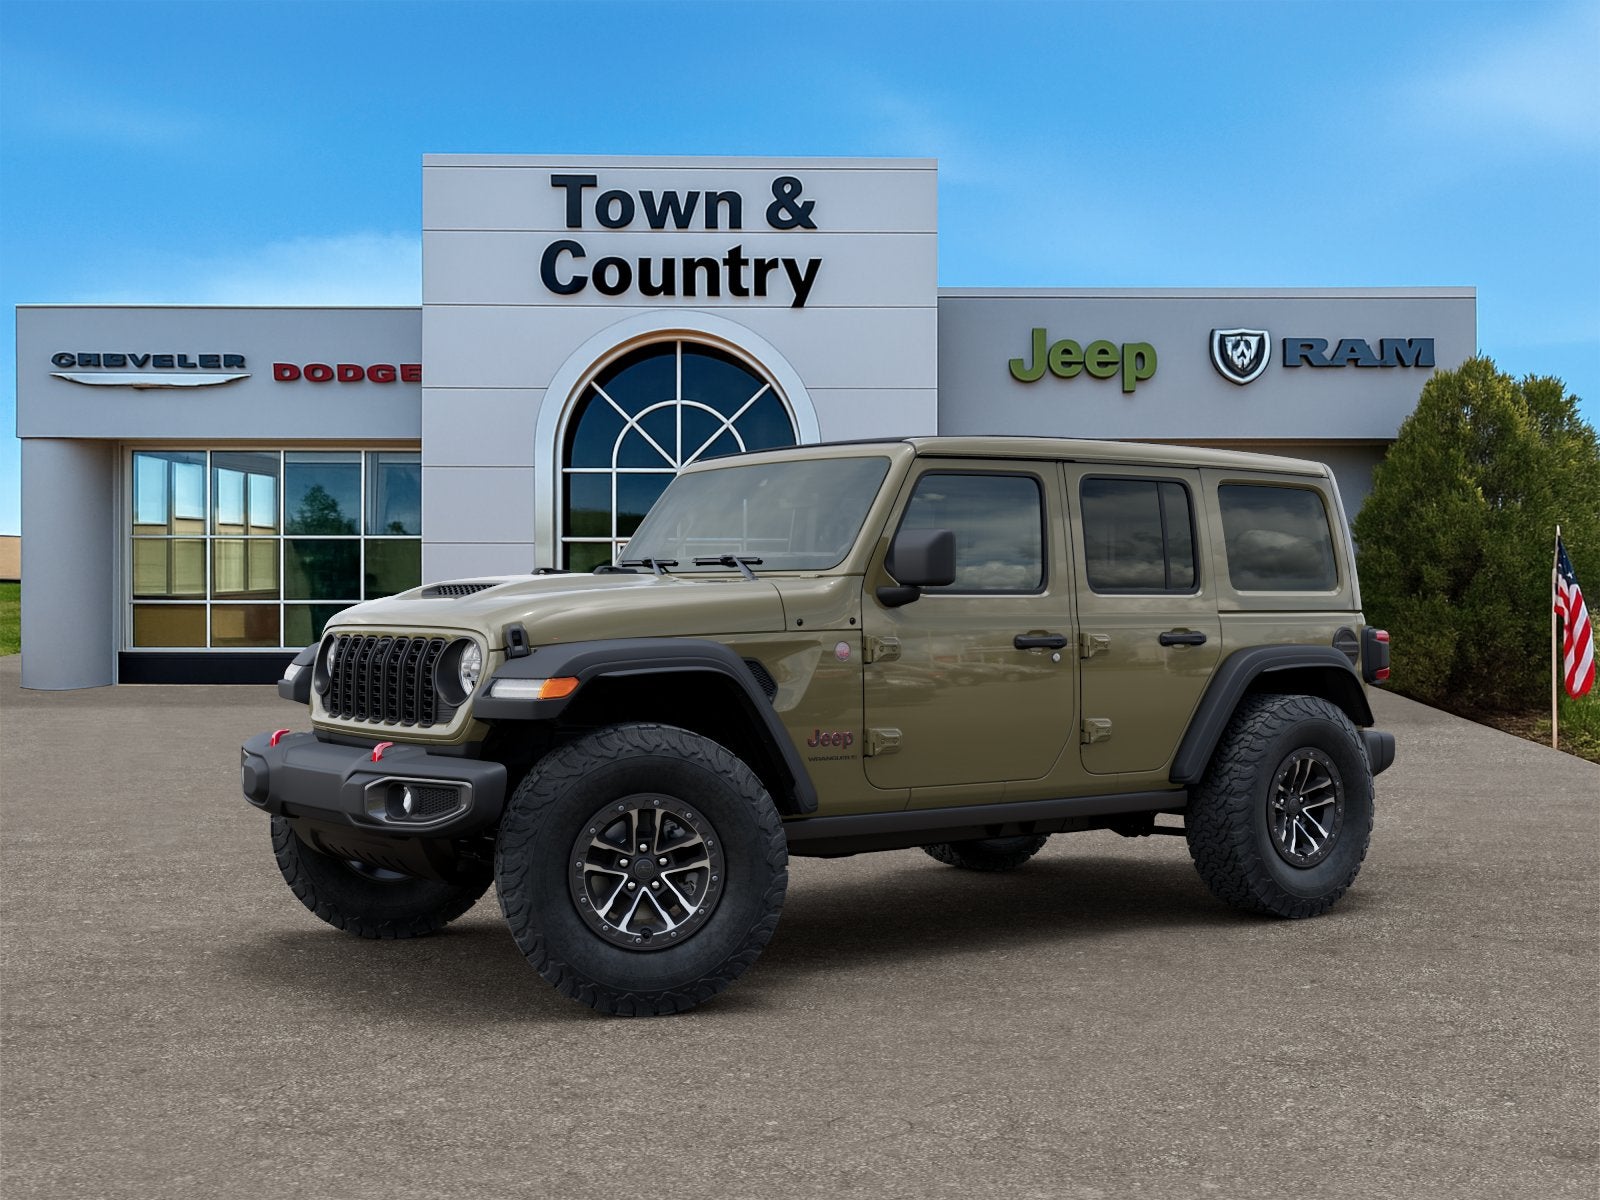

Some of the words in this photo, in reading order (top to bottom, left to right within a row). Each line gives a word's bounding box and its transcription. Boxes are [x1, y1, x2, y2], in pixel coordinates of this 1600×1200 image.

[550, 174, 742, 230] Town
[765, 175, 818, 230] &
[539, 239, 822, 308] Country
[1009, 327, 1157, 393] Jeep
[1283, 337, 1435, 368] RAM
[807, 729, 854, 750] Jeep
